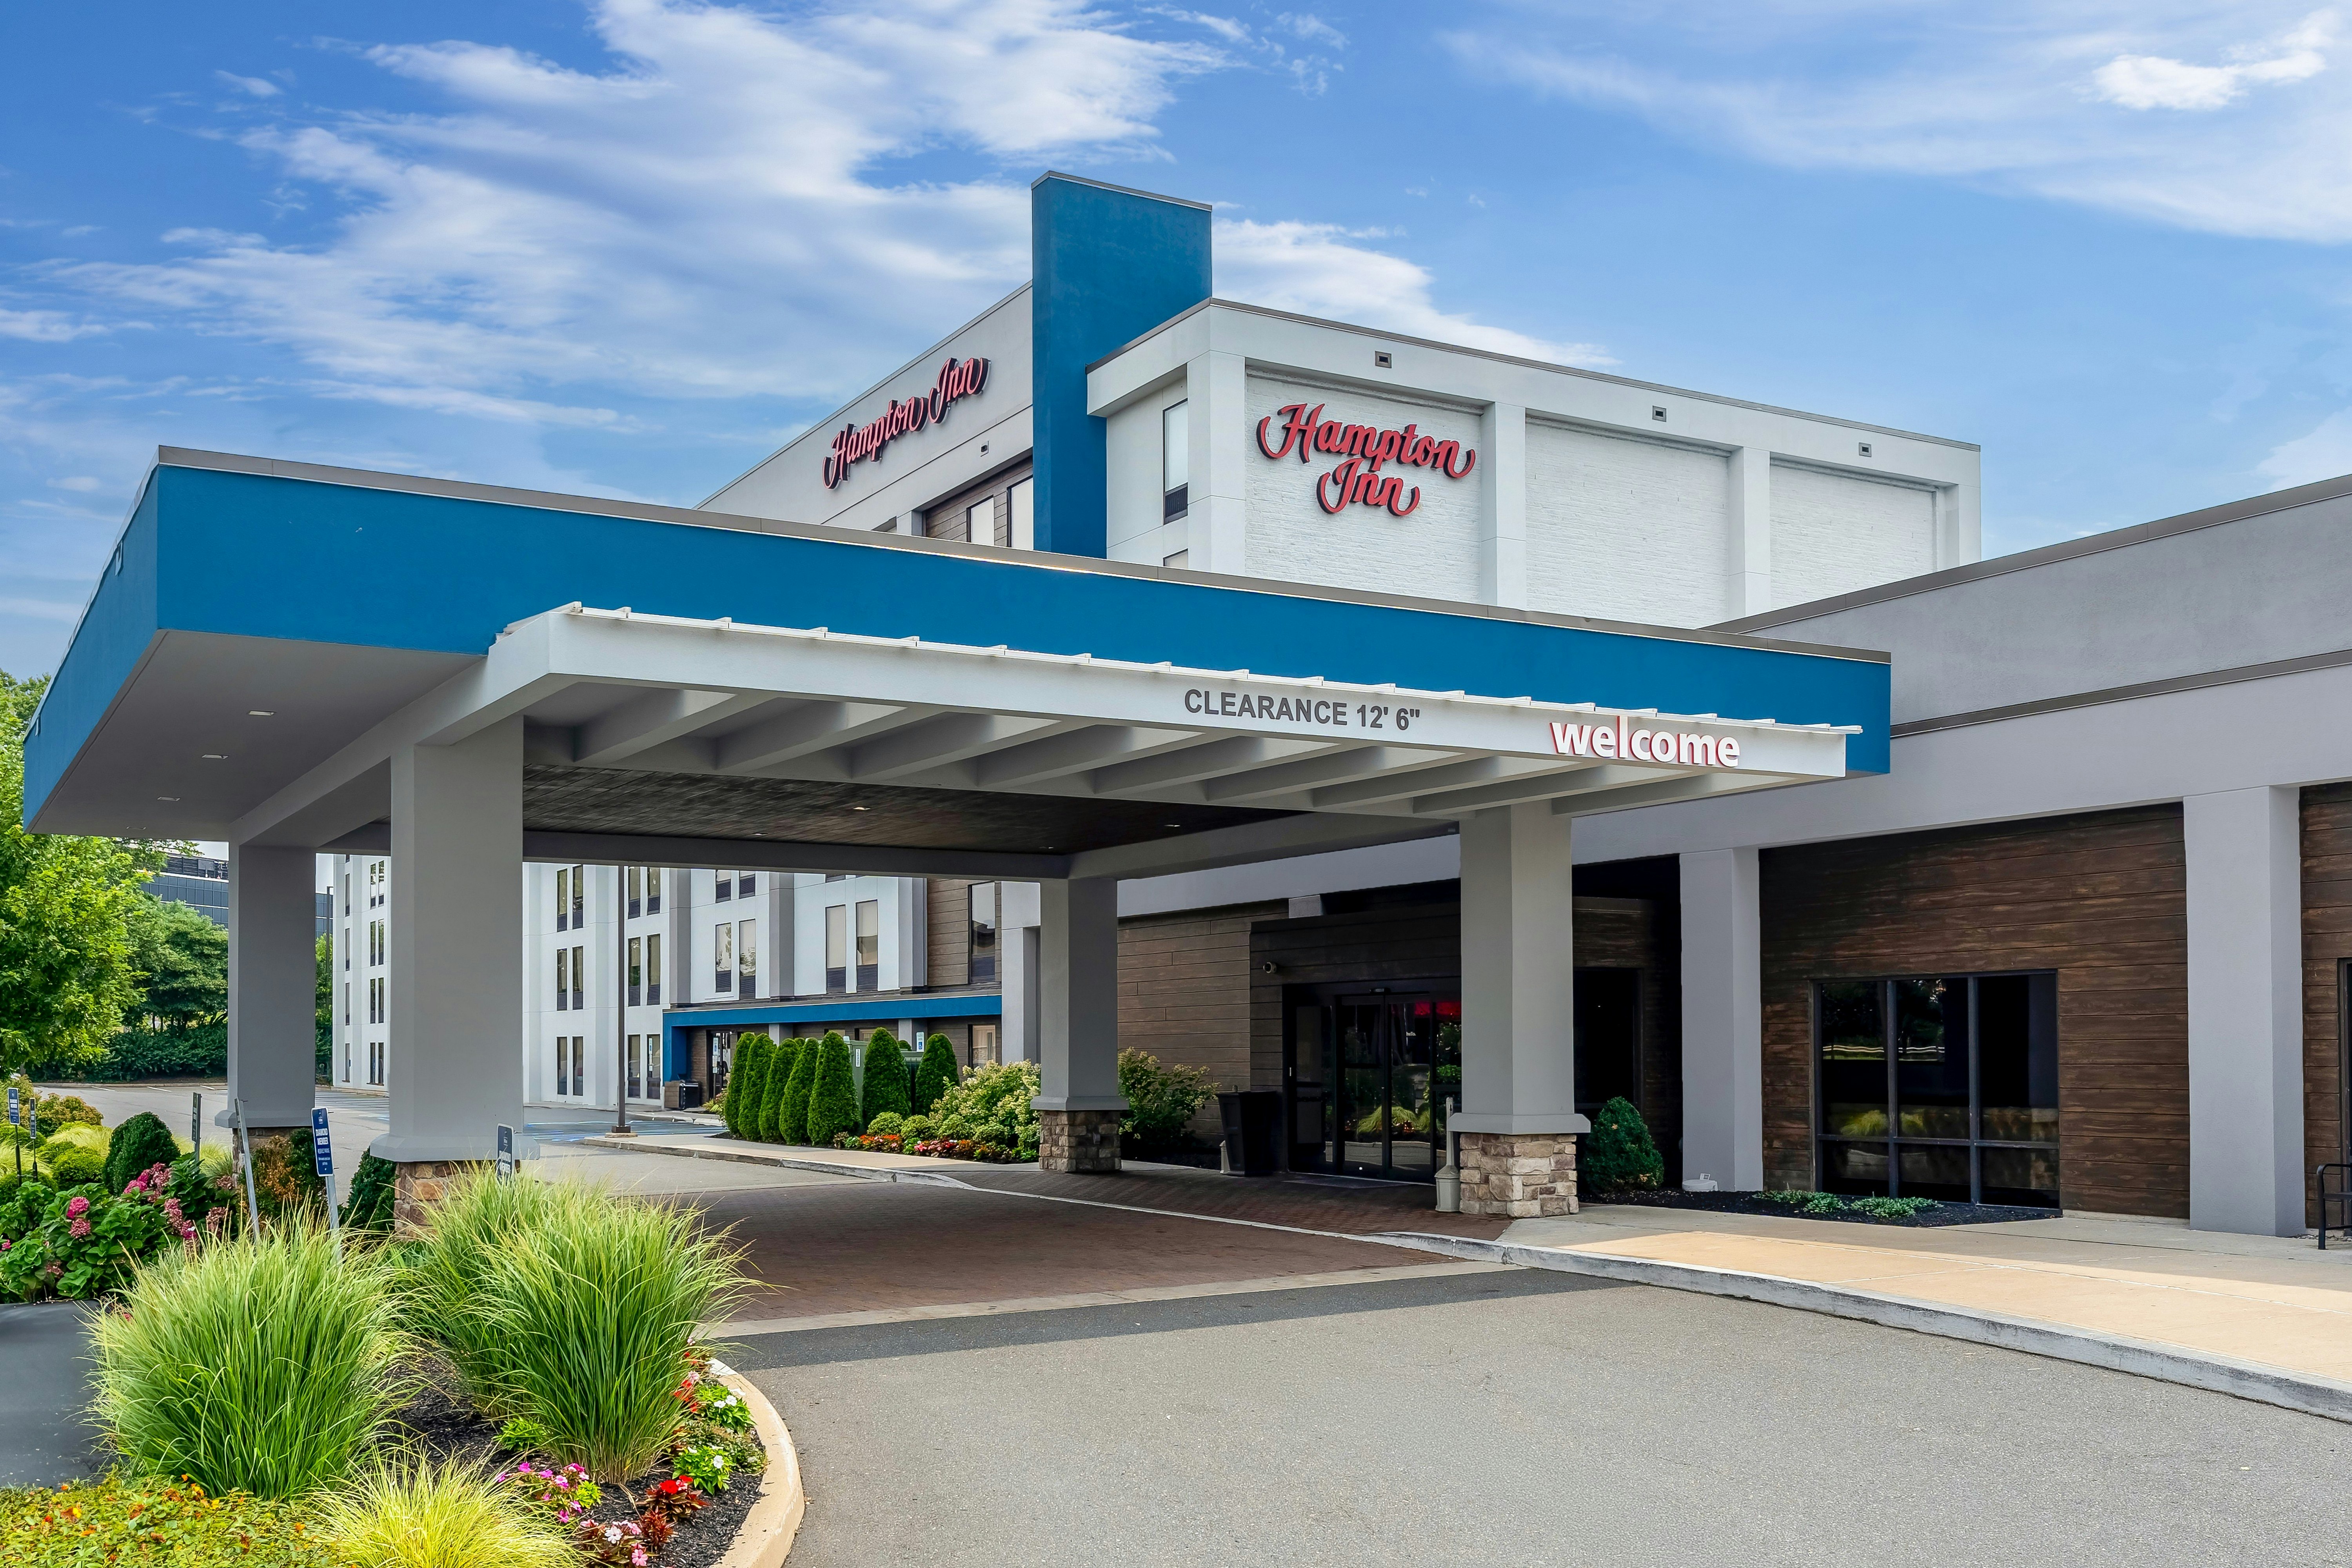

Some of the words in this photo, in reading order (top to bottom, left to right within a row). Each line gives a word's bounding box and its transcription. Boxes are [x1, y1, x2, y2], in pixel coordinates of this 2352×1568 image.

[823, 396, 928, 490] Hampton
[928, 357, 991, 424] Inn
[1256, 403, 1476, 478] Hampton
[1316, 458, 1420, 516] Inn
[1184, 689, 1348, 726] CLEARANCE
[1357, 704, 1388, 729] 12'
[1396, 708, 1420, 731] 6"
[1549, 716, 1740, 767] welcome
